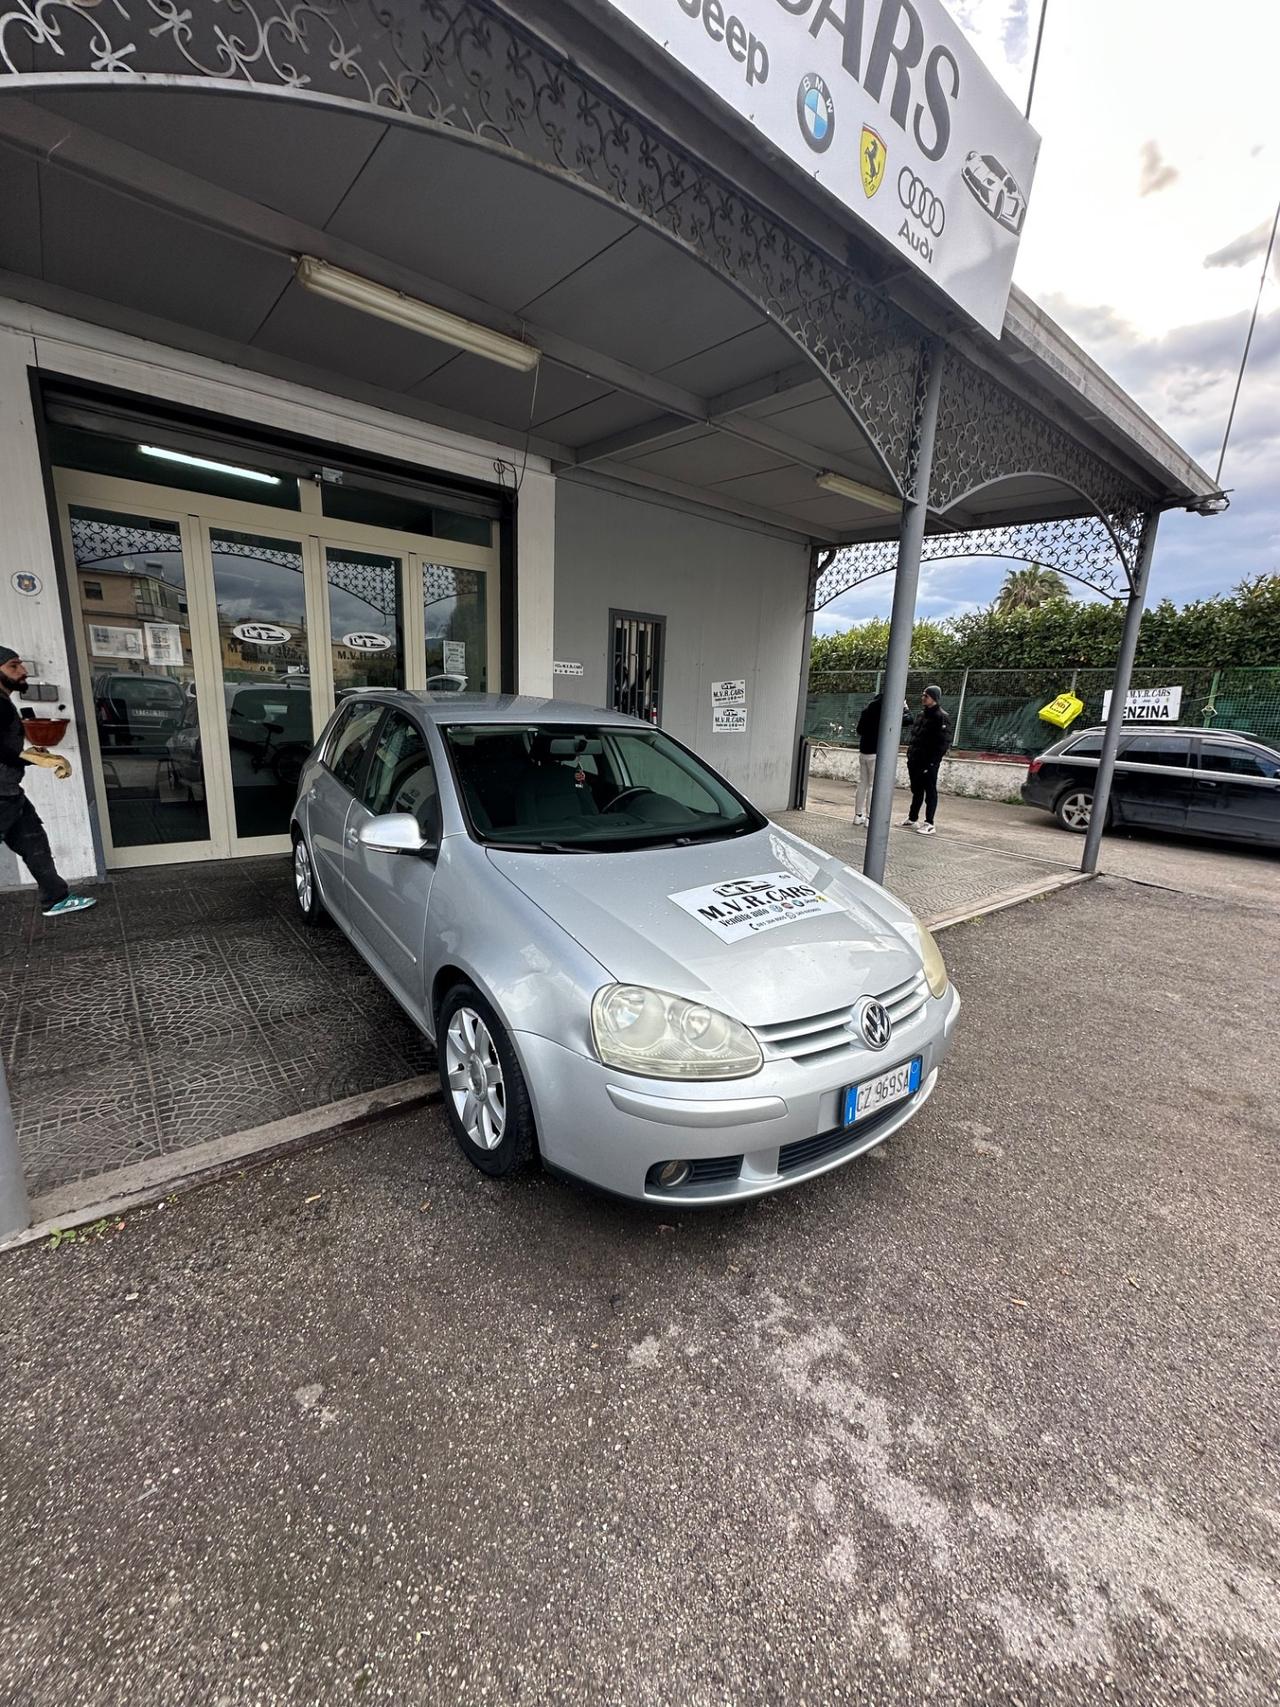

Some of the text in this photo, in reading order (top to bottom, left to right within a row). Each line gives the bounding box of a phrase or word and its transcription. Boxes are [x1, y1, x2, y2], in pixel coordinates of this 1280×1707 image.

[802, 74, 834, 114] BMW
[898, 219, 934, 264] Audi
[1122, 705, 1170, 719] ENZINA
[718, 912, 752, 928] Vendita
[752, 907, 770, 918] auto
[856, 1085, 872, 1113] CZ
